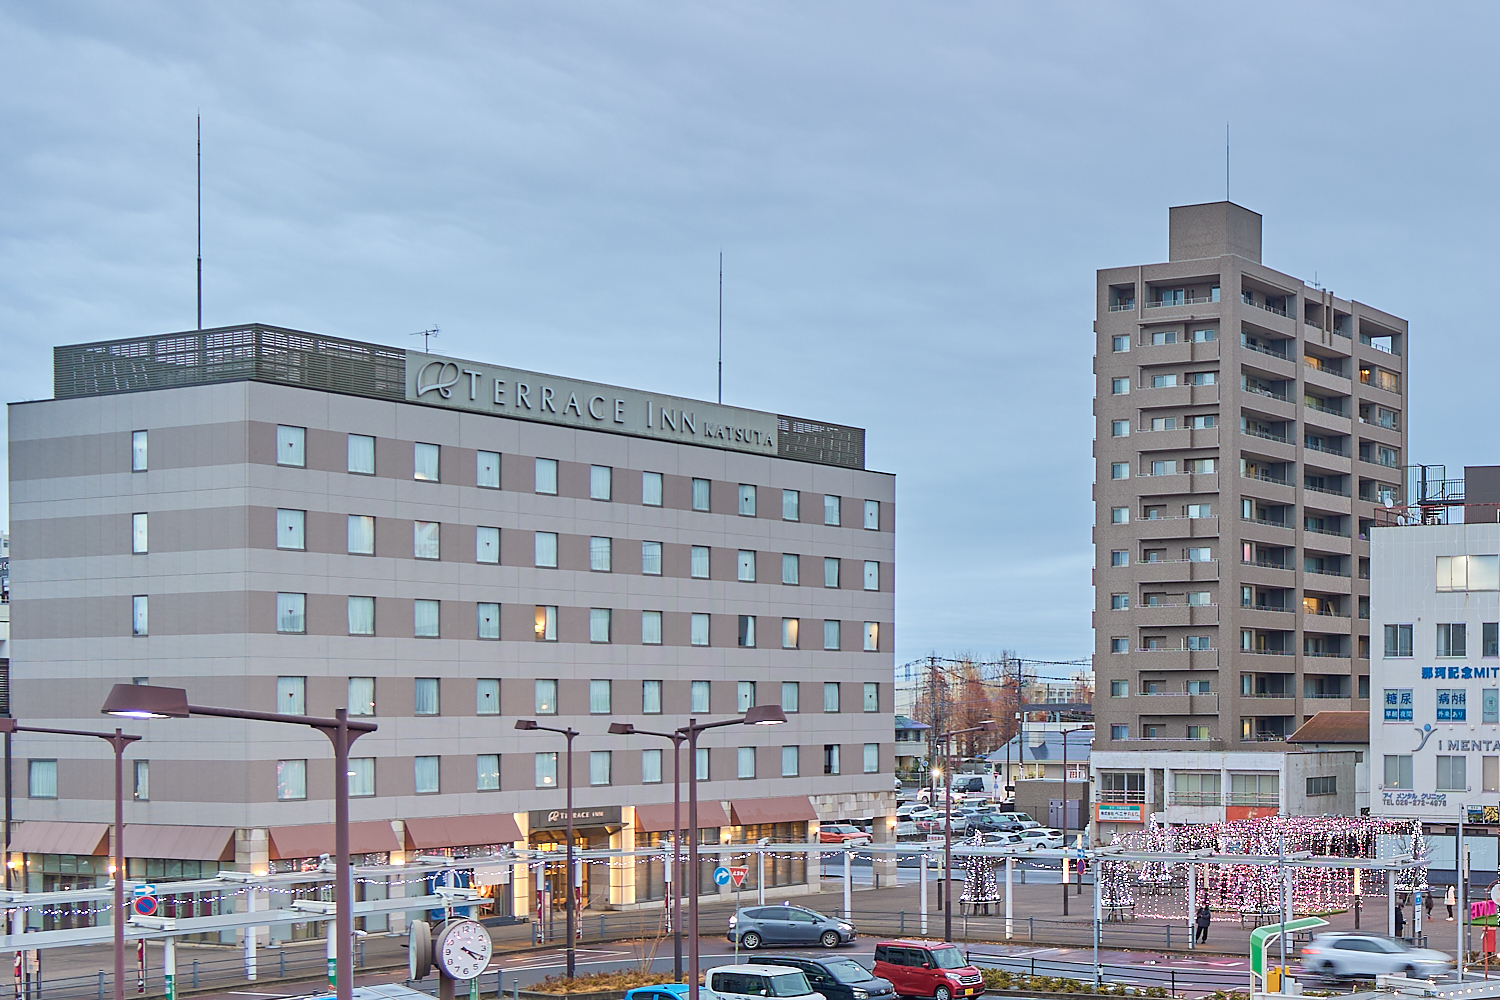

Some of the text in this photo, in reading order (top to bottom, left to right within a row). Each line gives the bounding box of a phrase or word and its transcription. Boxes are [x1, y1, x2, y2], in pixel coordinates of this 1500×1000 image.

[462, 368, 775, 448] TERRACE INN KATSUTA
[592, 810, 604, 818] INN
